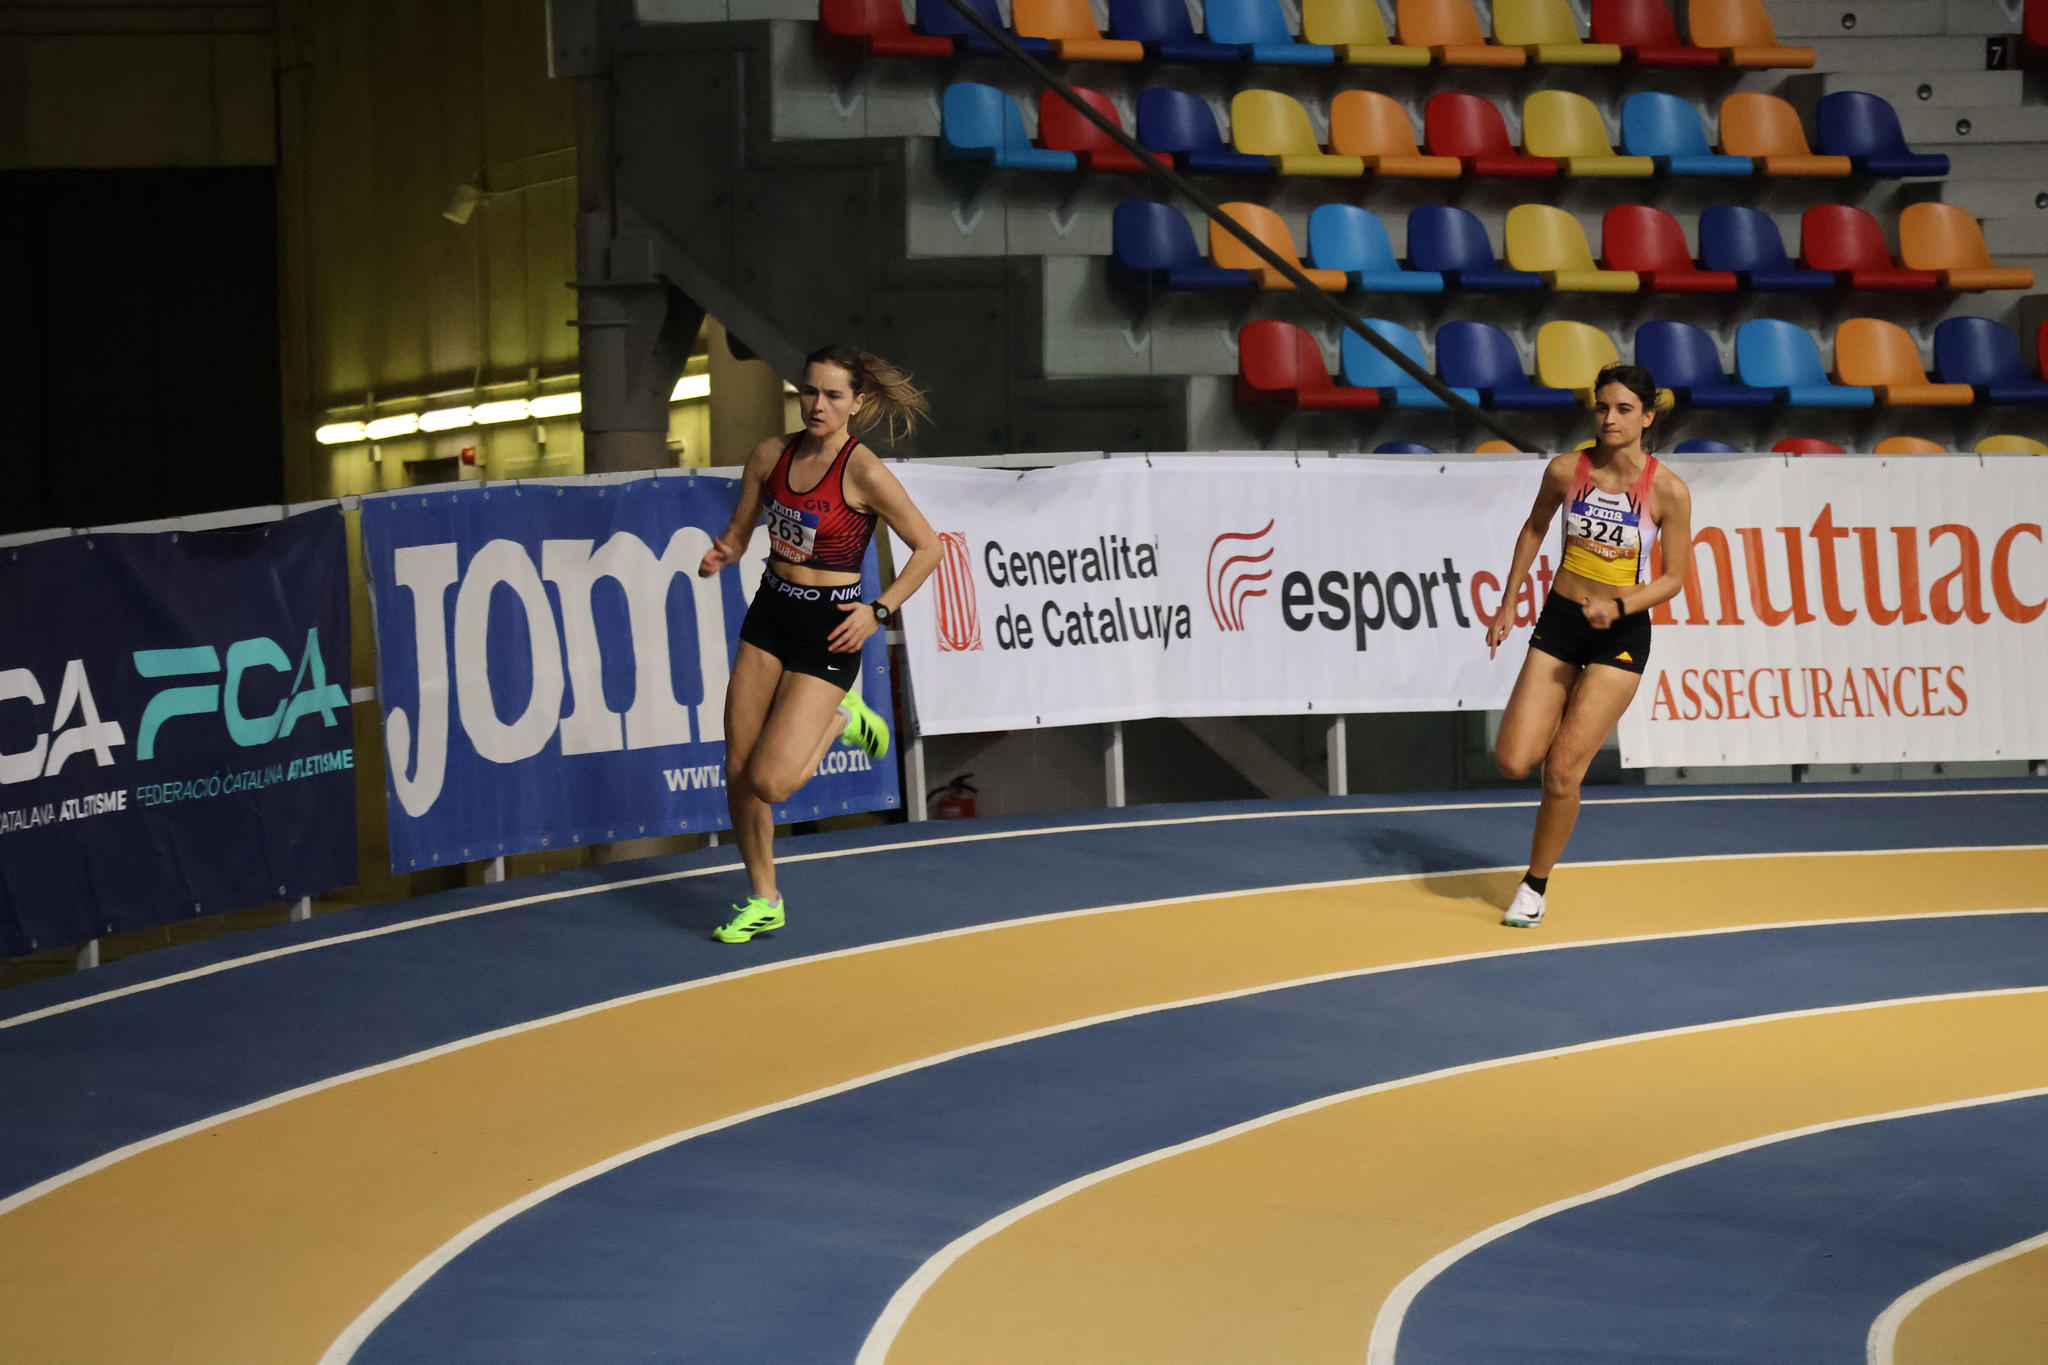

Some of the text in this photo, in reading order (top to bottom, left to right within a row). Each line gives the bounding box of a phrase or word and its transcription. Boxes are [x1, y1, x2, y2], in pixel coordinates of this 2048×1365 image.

[1991, 45, 2003, 66] 7
[768, 511, 804, 548] 263
[1578, 517, 1624, 547] 324
[778, 582, 820, 601] PRO
[1282, 555, 1554, 651] esportcat
[995, 603, 1034, 650] de
[133, 627, 349, 761] FCA
[1650, 665, 1968, 720] ASSEGURANCES
[286, 748, 355, 782] ATLETISME
